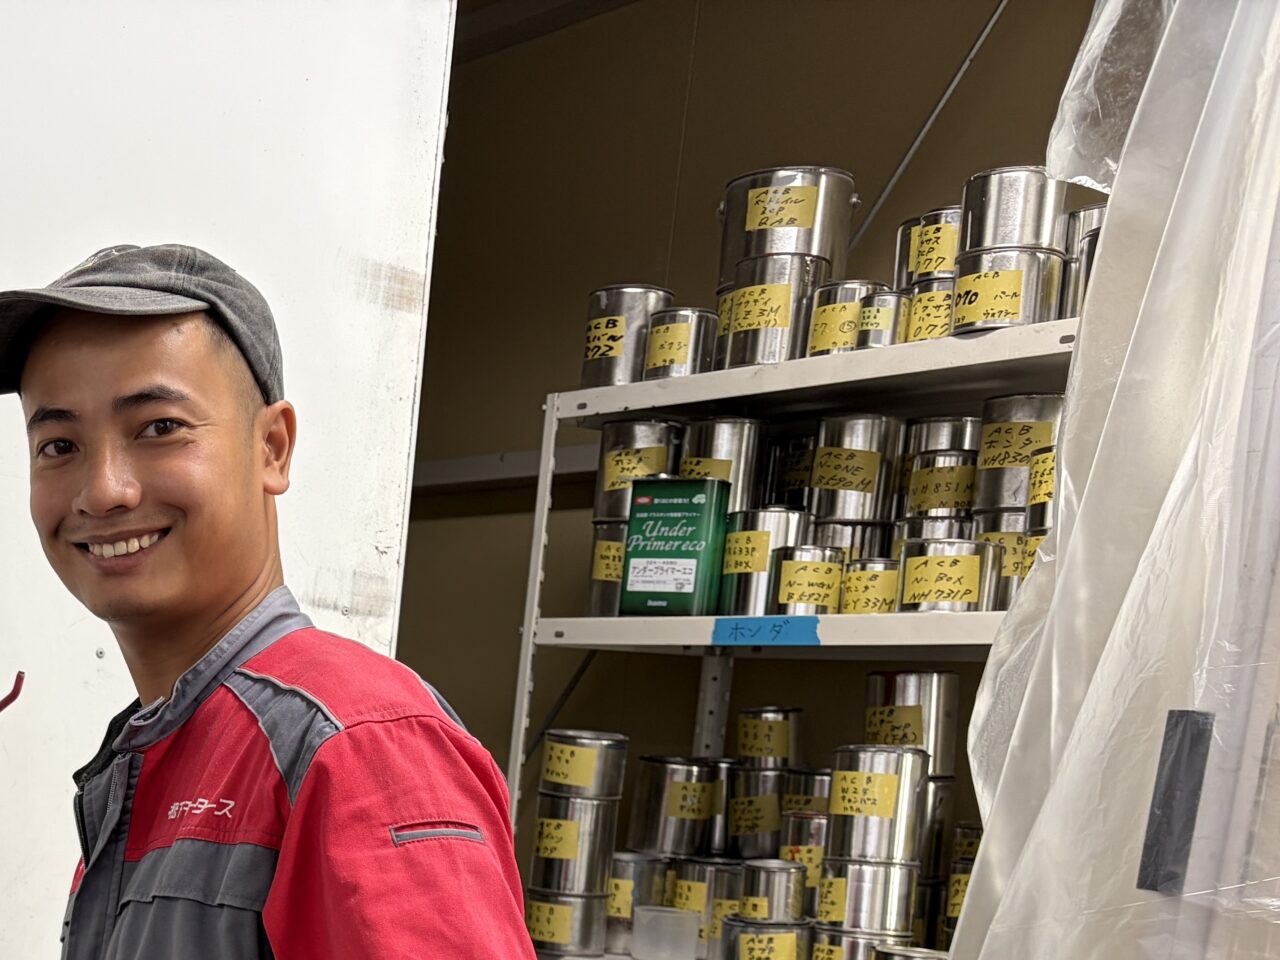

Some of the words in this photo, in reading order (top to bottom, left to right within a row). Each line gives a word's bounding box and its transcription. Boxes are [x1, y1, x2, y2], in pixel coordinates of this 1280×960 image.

[973, 271, 1000, 282] ACB
[988, 425, 1033, 438] ACB
[984, 438, 1041, 450] ホンダ
[821, 451, 856, 460] ACB
[981, 453, 1032, 467] NH830
[818, 460, 865, 476] N-ONE
[642, 519, 696, 537] Under
[631, 566, 694, 576] アンダープライマーエコ
[794, 564, 833, 575] ACB
[914, 559, 960, 570] ACB
[911, 572, 965, 586] N-BOX
[909, 587, 973, 602] NH731P
[728, 619, 790, 642] ホンダ
